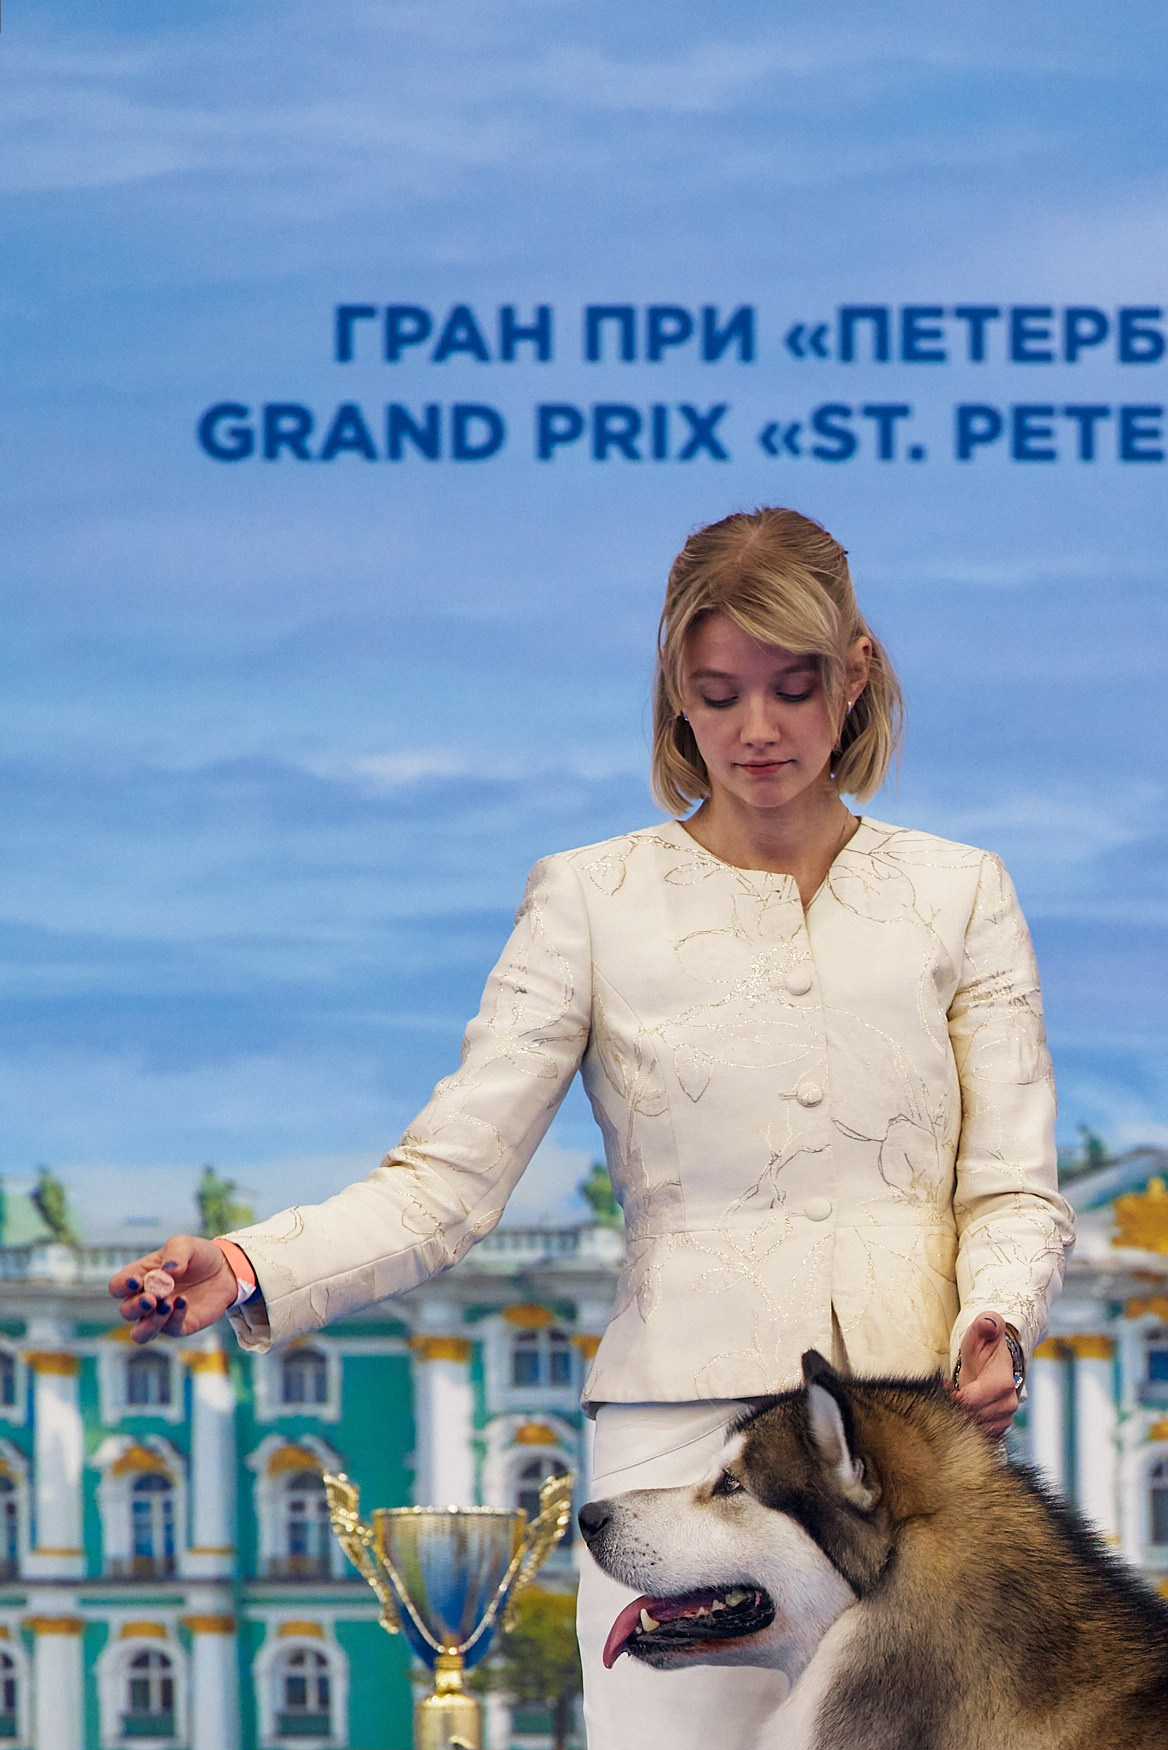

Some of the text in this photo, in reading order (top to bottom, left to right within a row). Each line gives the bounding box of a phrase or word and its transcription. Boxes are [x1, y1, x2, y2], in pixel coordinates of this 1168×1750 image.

[334, 303, 554, 366] ГРАН
[584, 304, 758, 366] ПРИ
[195, 401, 508, 466] GRAND
[536, 401, 731, 464] PRIX
[757, 402, 928, 465] «ST.
